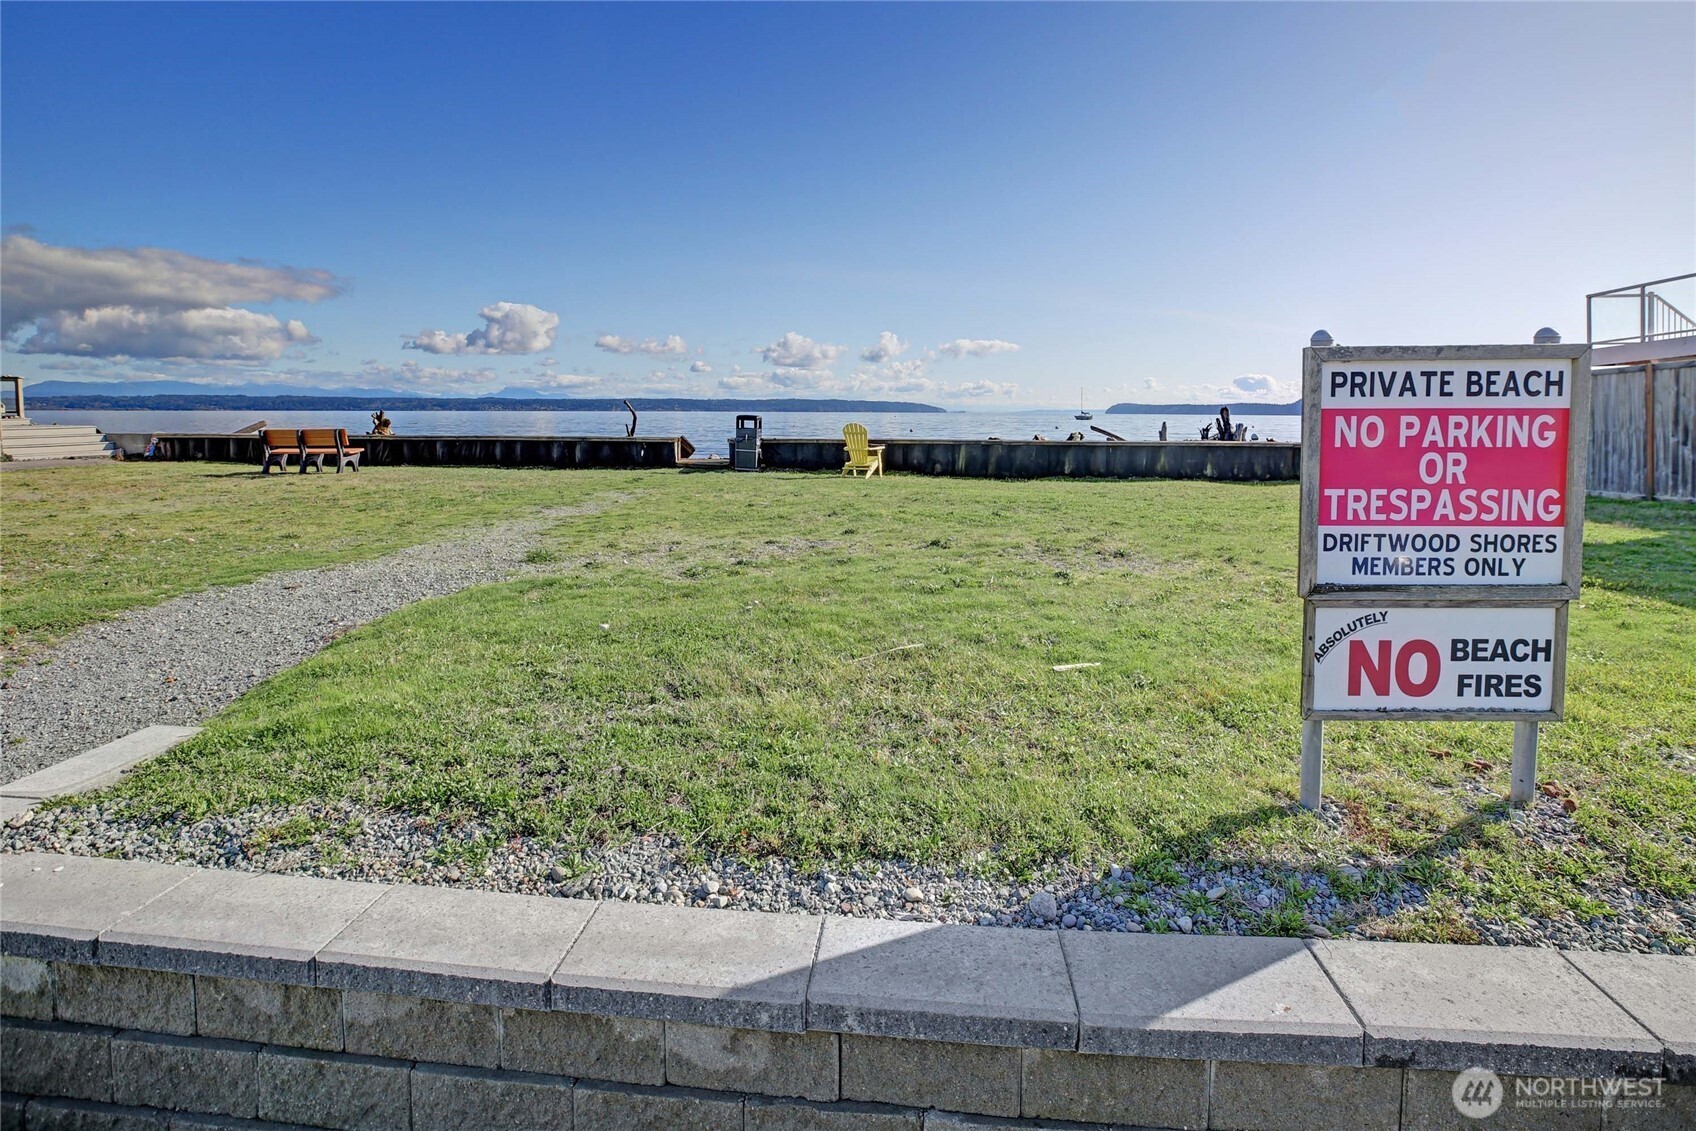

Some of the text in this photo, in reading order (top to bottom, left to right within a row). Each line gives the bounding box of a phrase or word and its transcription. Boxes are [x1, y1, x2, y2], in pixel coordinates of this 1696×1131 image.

[1330, 370, 1564, 398] PRIVATE BEACH
[1334, 414, 1557, 448] NO PARKING
[1419, 452, 1468, 485] OR
[1324, 488, 1561, 522] TRESPASSING
[1322, 533, 1557, 553] DRIFTWOOD SHORES
[1352, 557, 1526, 577] MEMBERS ONLY
[1313, 611, 1388, 663] ABSOLUTELY
[1450, 638, 1552, 662] BEACH
[1347, 639, 1441, 697] NO
[1456, 674, 1542, 697] FIRES
